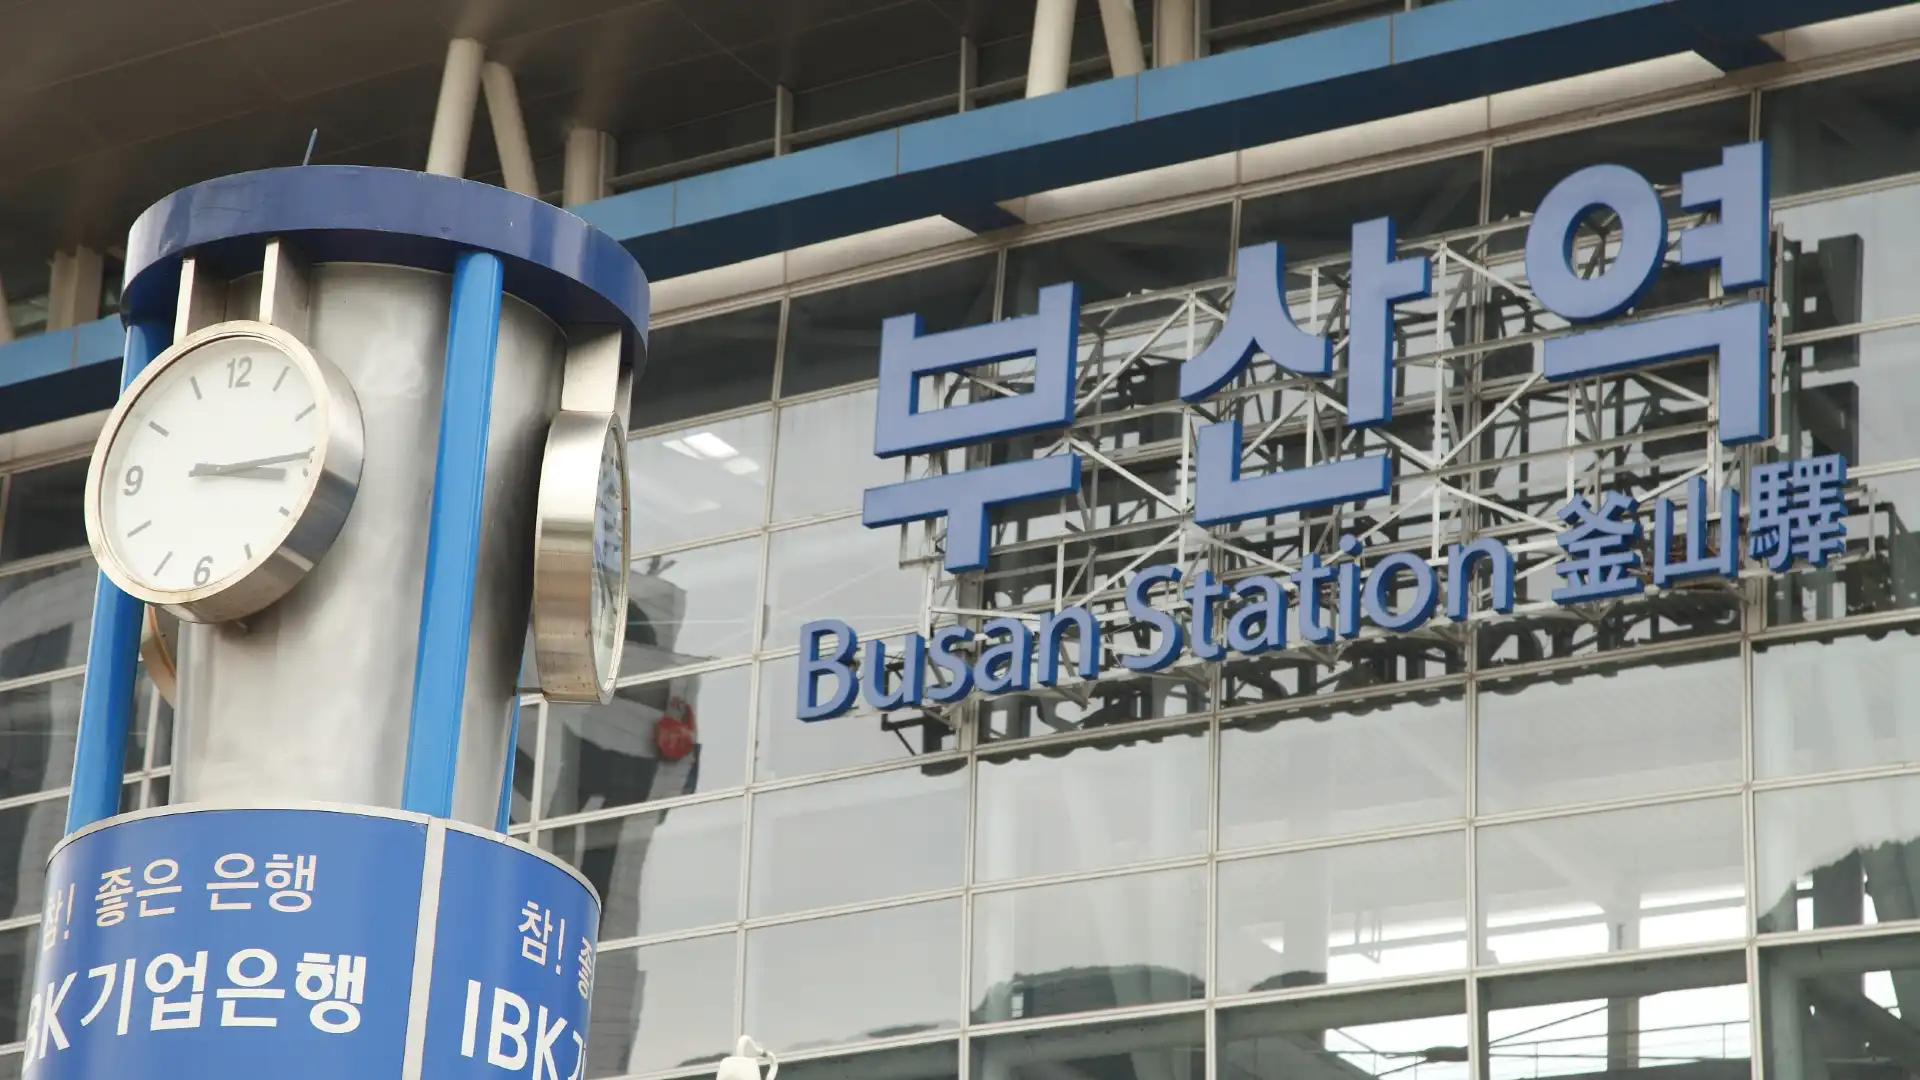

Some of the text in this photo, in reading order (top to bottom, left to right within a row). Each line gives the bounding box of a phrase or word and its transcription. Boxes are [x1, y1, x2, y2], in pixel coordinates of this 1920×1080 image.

[226, 356, 252, 388] 12
[862, 140, 1771, 573] 부산역
[124, 465, 144, 496] 9
[1551, 453, 1848, 605] 釜山驛
[193, 556, 214, 586] 6
[798, 536, 1516, 722] Busan Station
[95, 857, 183, 927] 좋은
[206, 852, 317, 913] 은행
[518, 900, 566, 976] 참!
